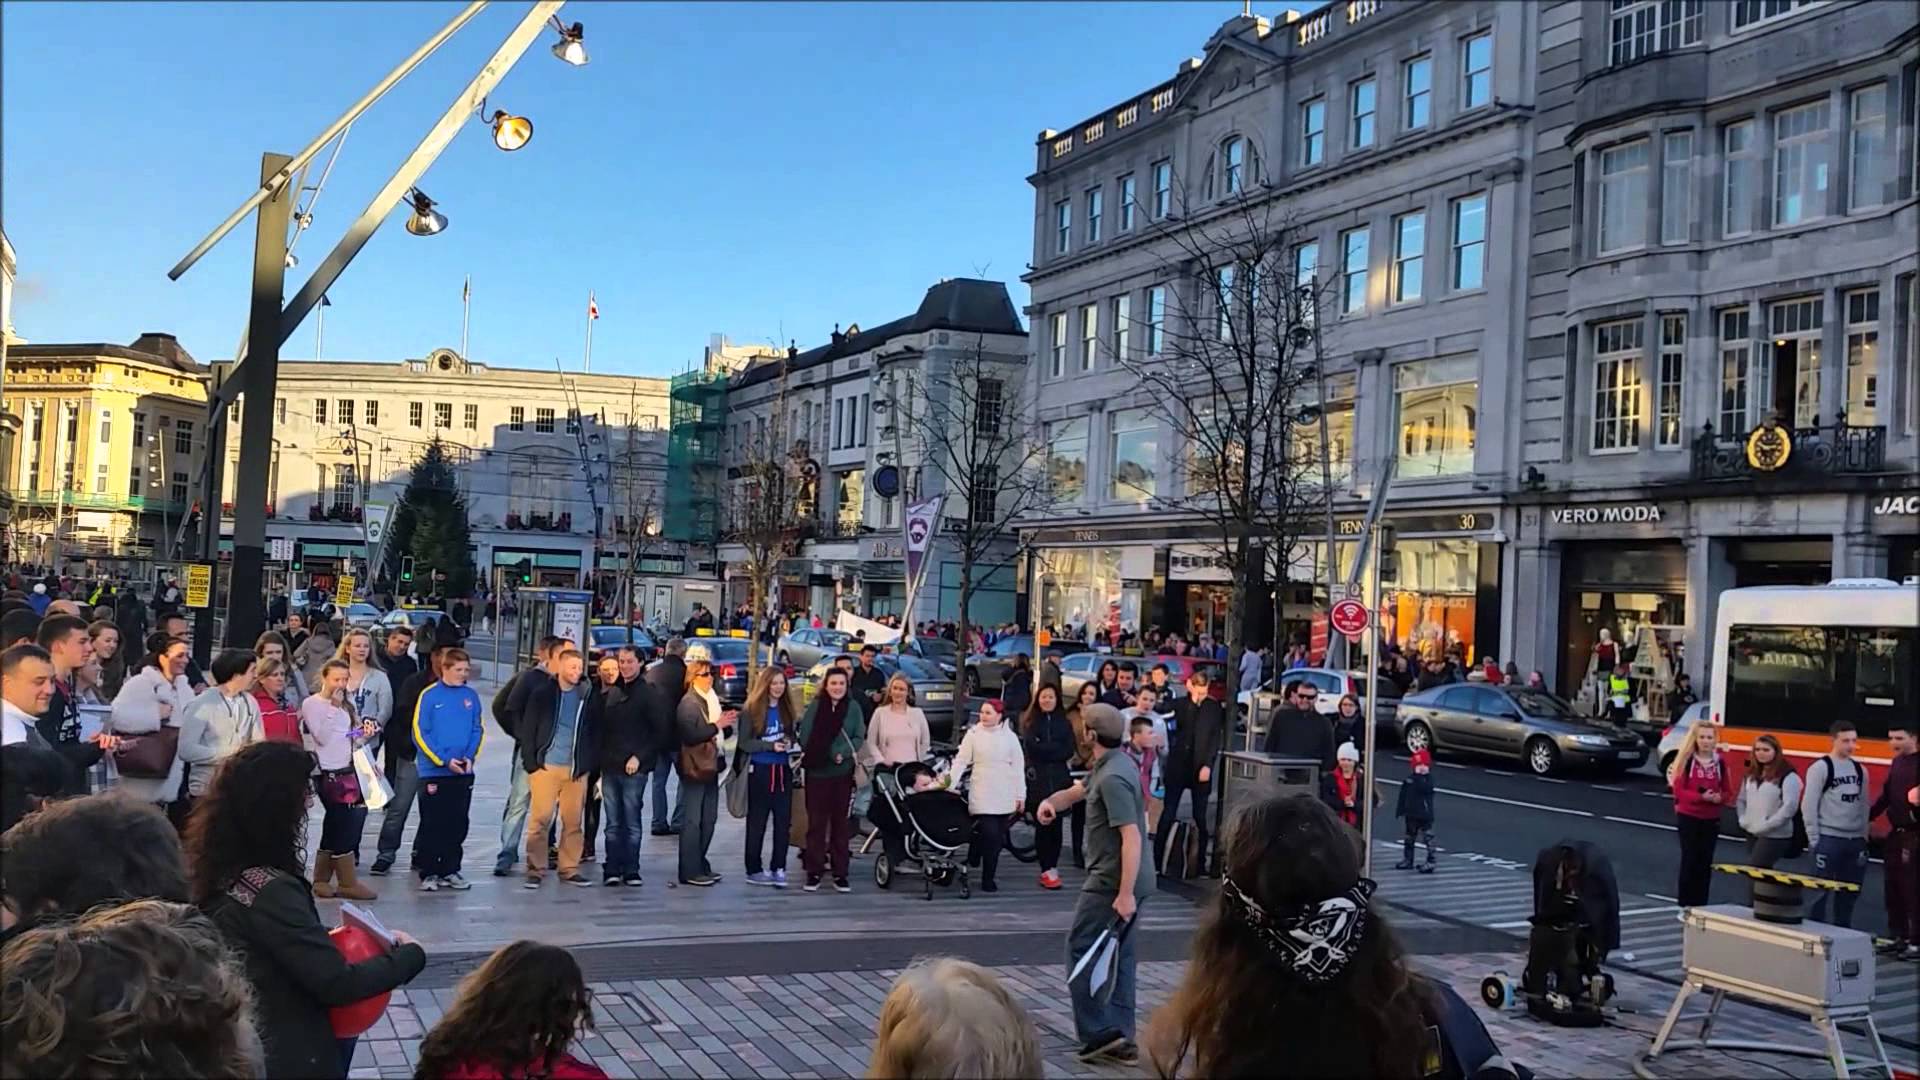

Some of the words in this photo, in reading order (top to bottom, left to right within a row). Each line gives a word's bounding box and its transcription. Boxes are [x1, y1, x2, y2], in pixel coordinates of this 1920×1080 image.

[1459, 513, 1476, 530] 30
[1551, 508, 1599, 523] VERO
[1603, 505, 1661, 522] MODA
